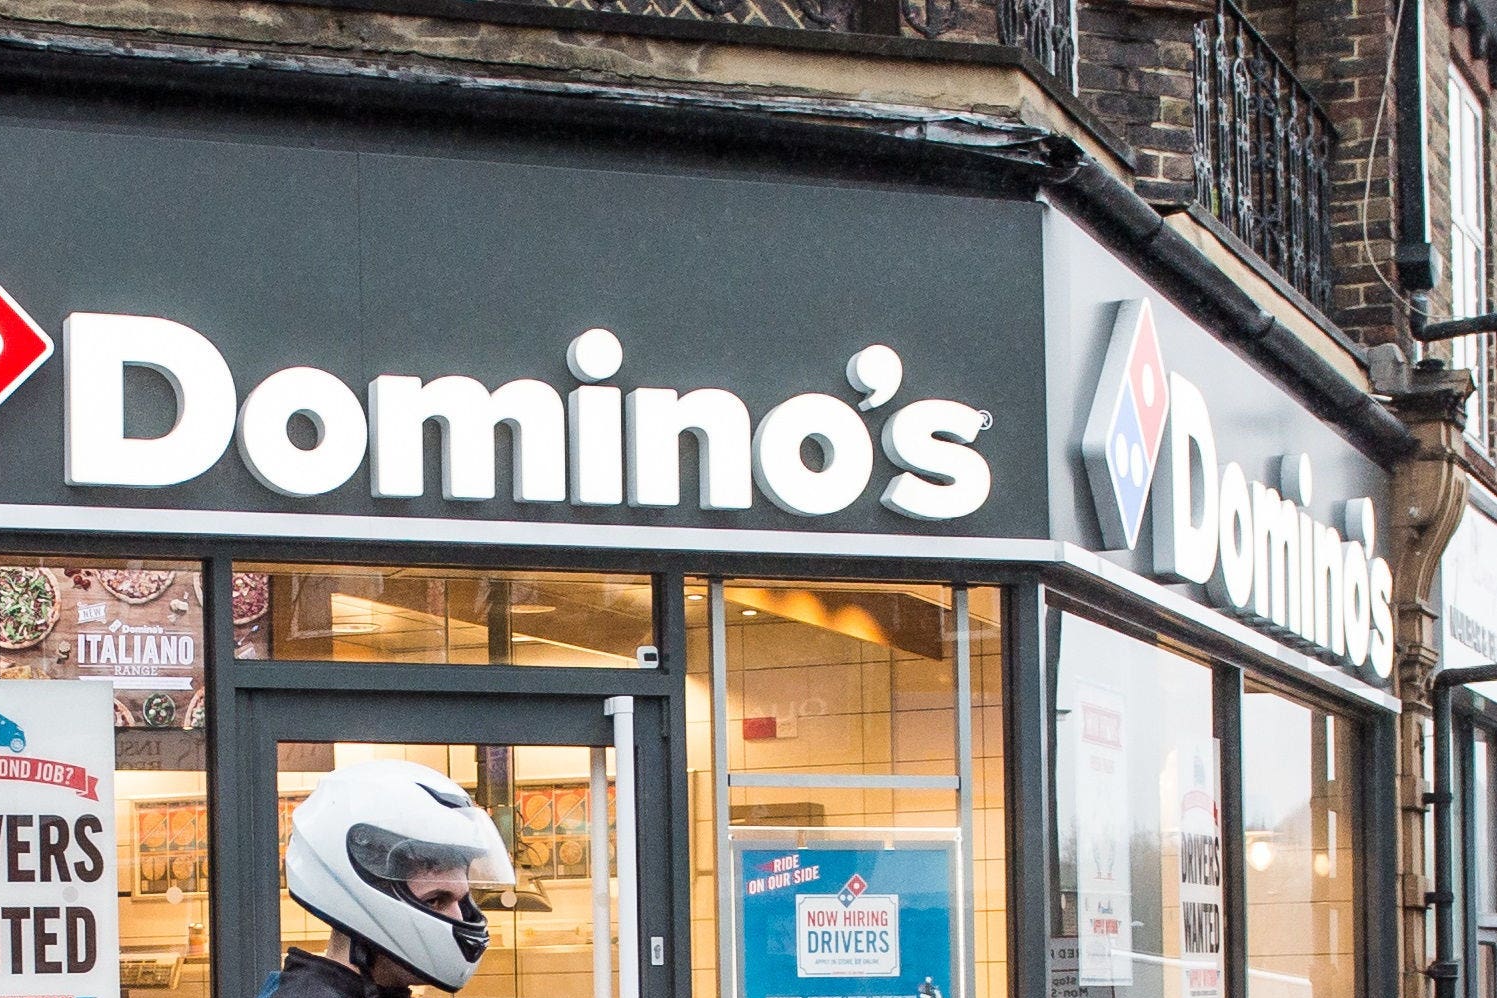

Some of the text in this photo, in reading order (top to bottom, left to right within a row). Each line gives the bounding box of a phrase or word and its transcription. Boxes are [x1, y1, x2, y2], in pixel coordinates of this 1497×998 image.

[62, 312, 992, 520] Domino's
[1156, 371, 1394, 679] Domino's
[82, 609, 102, 619] NEW
[77, 633, 194, 666] ITALIANO
[114, 665, 159, 677] RANGE
[35, 762, 75, 786] JOB?
[772, 855, 800, 873] RIDE
[747, 865, 820, 894] ON OUR SIDE
[807, 910, 888, 926] NOW HIRING
[808, 930, 890, 953] DRIVERS
